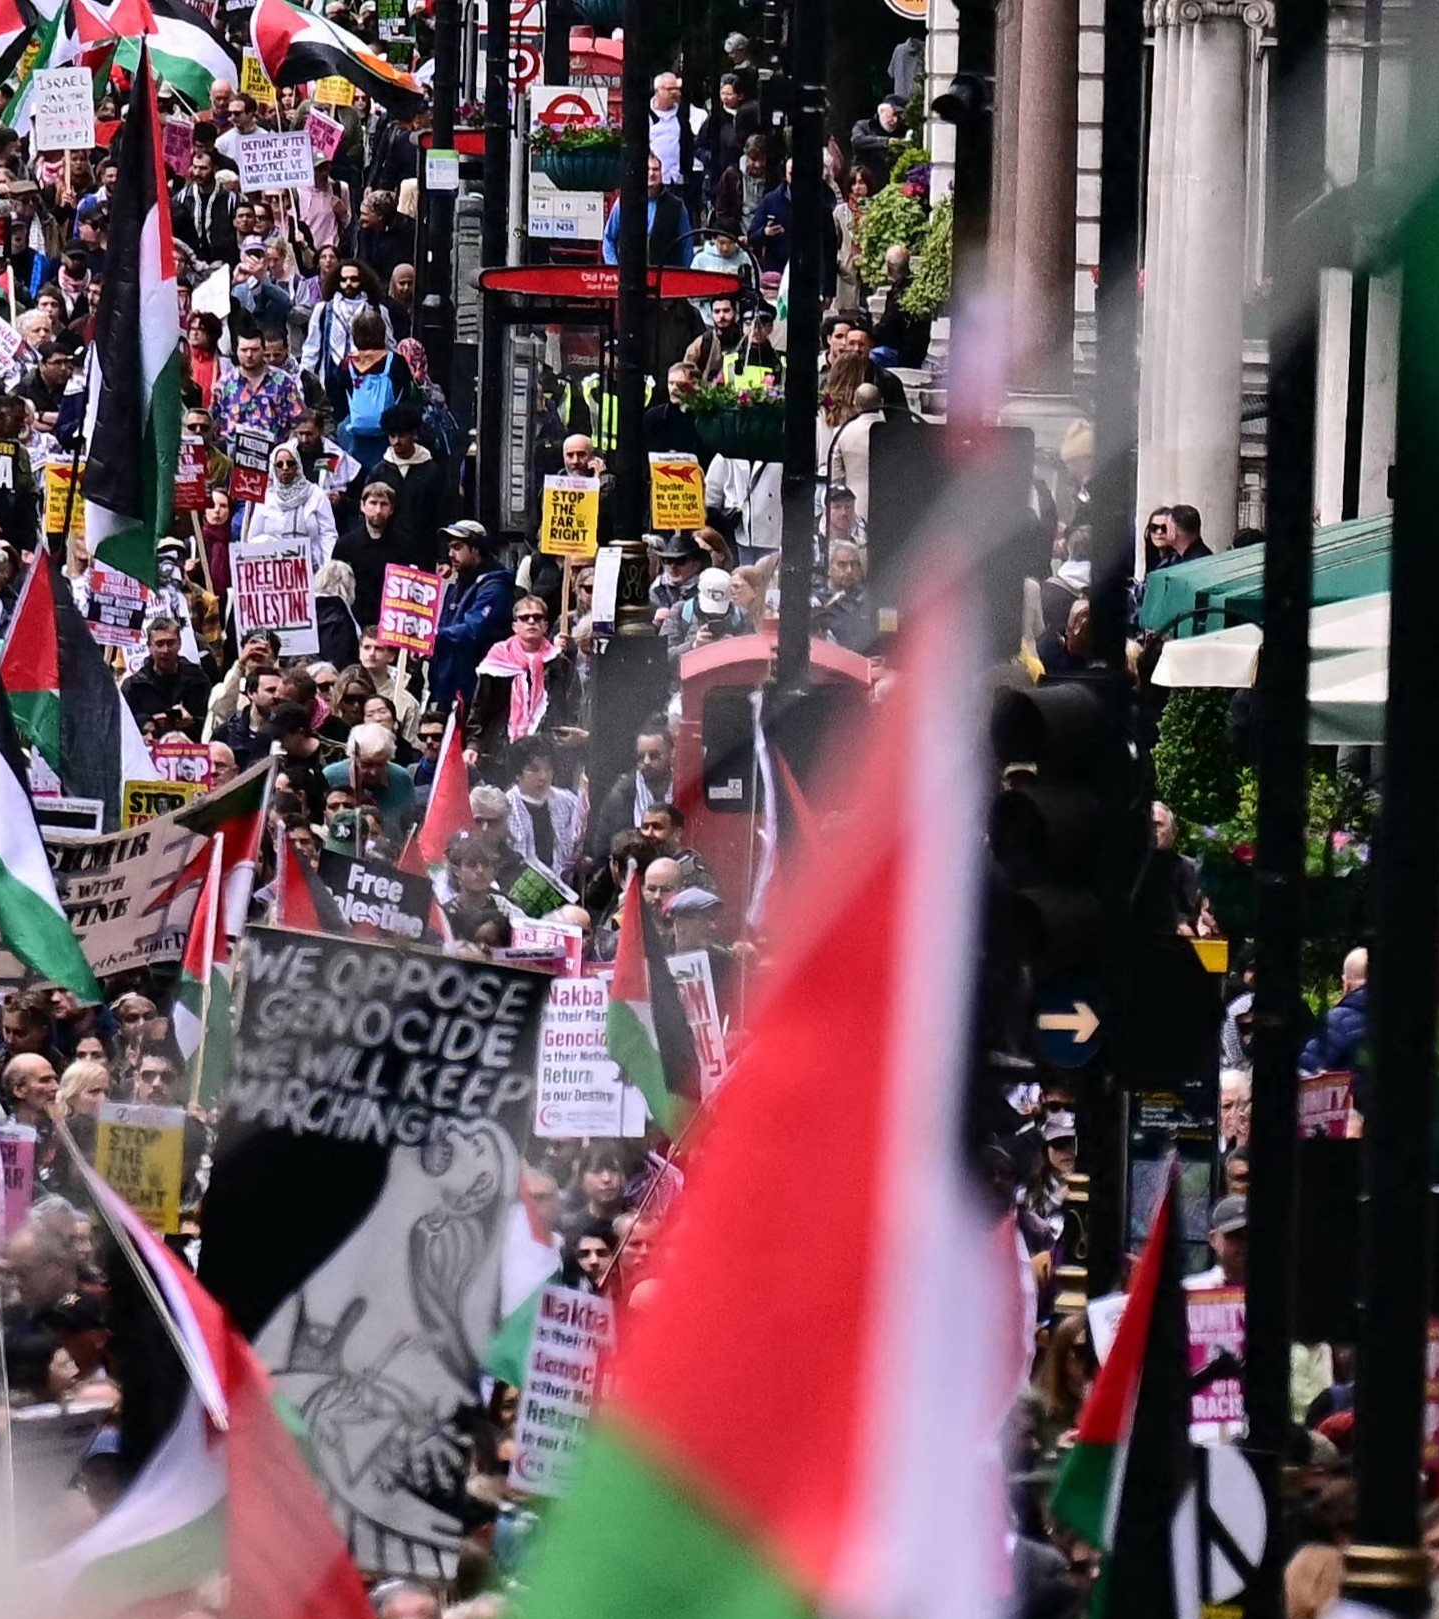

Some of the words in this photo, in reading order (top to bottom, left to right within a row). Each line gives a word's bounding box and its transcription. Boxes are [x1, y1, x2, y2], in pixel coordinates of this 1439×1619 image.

[37, 74, 90, 91] ISRAEL
[241, 138, 279, 151] DEFIANT
[552, 490, 585, 504] STOP
[551, 503, 576, 516] THE
[550, 515, 574, 528] FAR
[549, 527, 589, 542] RIGHT
[236, 559, 309, 593] FREEDOM
[386, 575, 437, 606] STOP
[239, 590, 311, 628] PALESTINE
[382, 610, 434, 640] STOP
[155, 757, 209, 781] STOP
[129, 790, 187, 816] STOP
[78, 876, 126, 897] WITH
[346, 862, 405, 903] Free
[324, 886, 425, 940] alestine
[244, 935, 322, 991] WE
[327, 952, 537, 1025] OPPOSE
[548, 984, 604, 1006] Nakba
[557, 1009, 583, 1023] their
[253, 987, 521, 1070] GENOCIDE
[554, 1051, 579, 1063] their
[296, 1045, 389, 1099] WILL
[400, 1060, 537, 1118] KEEP
[542, 1067, 595, 1085] Return
[541, 1088, 552, 1102] is
[541, 1292, 610, 1338] Nakba
